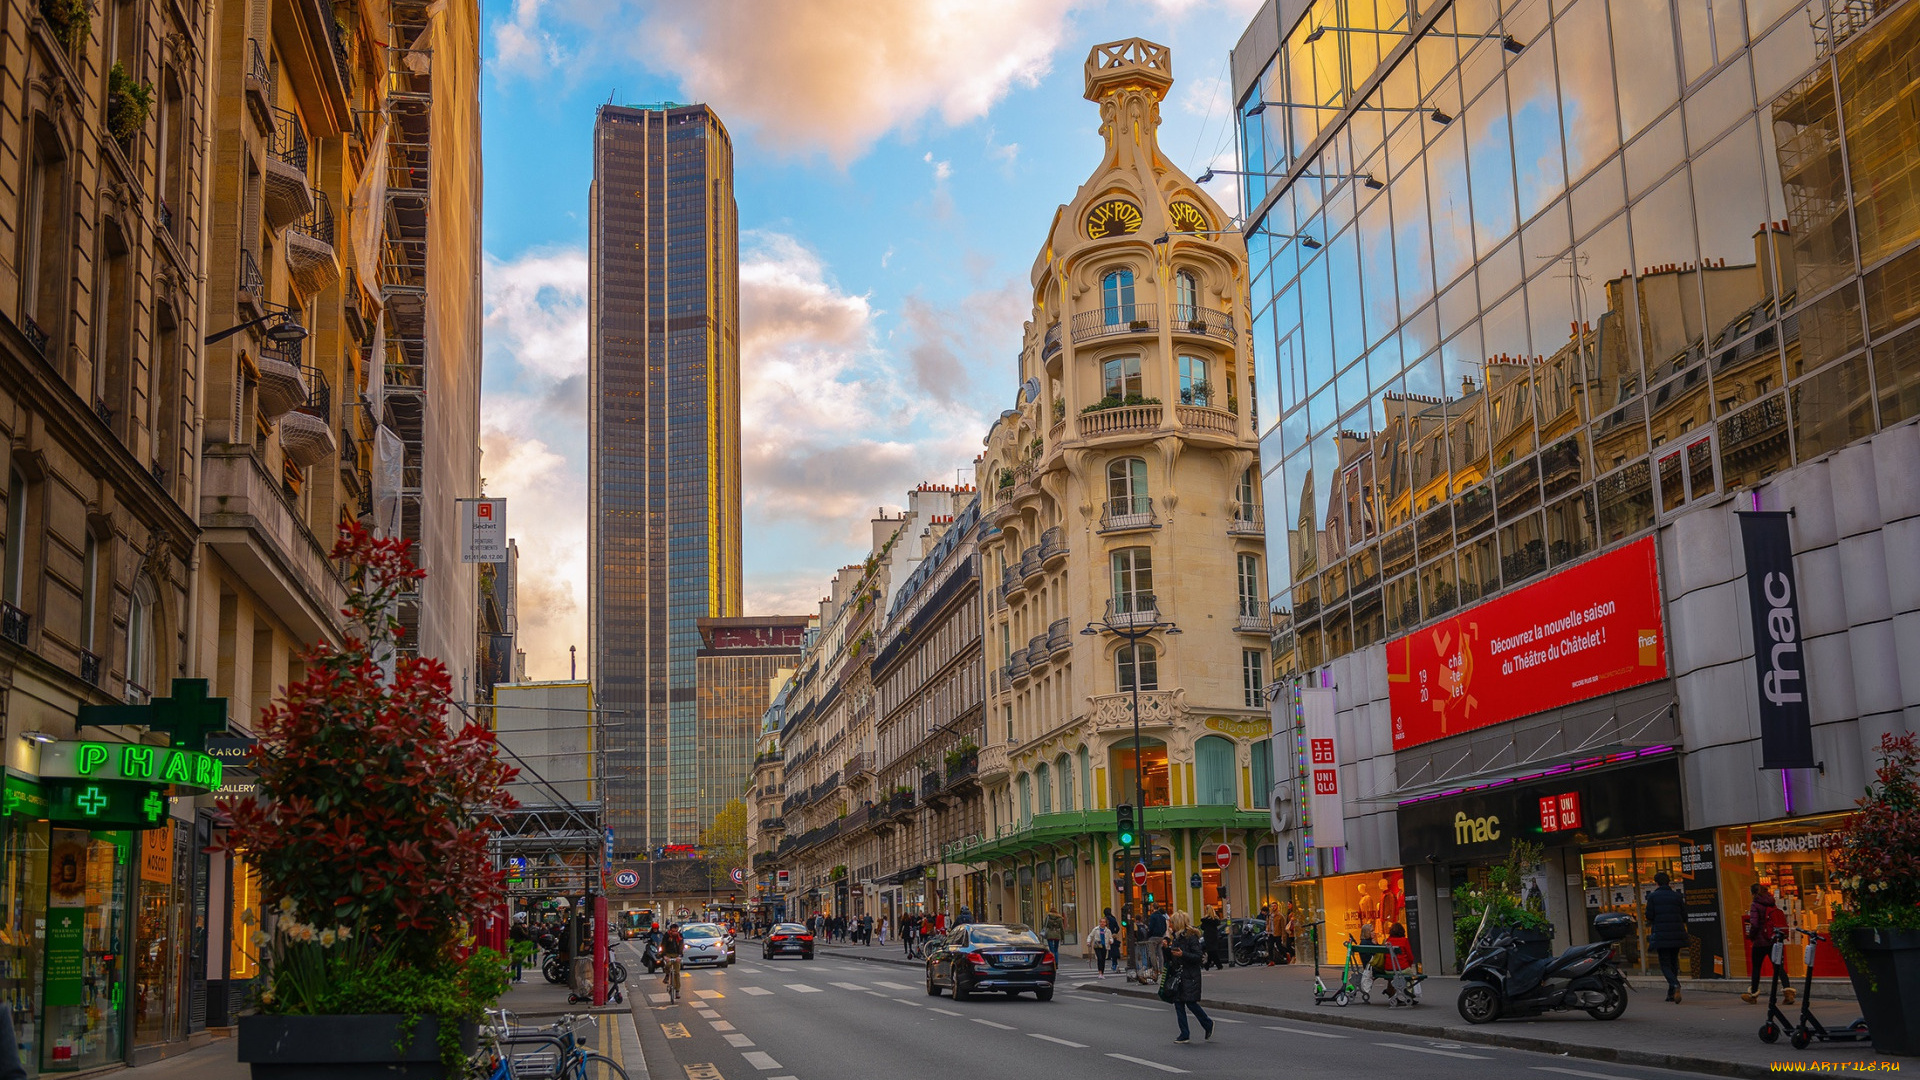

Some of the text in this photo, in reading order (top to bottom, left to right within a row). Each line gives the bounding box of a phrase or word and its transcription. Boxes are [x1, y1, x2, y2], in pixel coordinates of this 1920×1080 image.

[1490, 600, 1616, 655] Découvrez la nouvelle saison
[1637, 634, 1658, 649] fnac
[1763, 571, 1802, 706] fnac
[1502, 659, 1514, 676] du
[1513, 649, 1547, 672] Théâtre
[1547, 642, 1560, 660] du
[1560, 629, 1602, 656] Châtelet
[1448, 652, 1463, 669] châ
[1418, 669, 1428, 684] 19
[1419, 687, 1429, 703] 20
[1451, 683, 1464, 698] let
[1217, 719, 1268, 735] BISCUITS
[1316, 772, 1334, 781] UNI
[1317, 782, 1335, 792] QLO
[1560, 797, 1574, 811] UNI
[1562, 811, 1576, 825] QLO
[1454, 811, 1501, 845] fnac
[1724, 844, 1750, 857] FNAC,
[1750, 839, 1775, 853] C'EST
[1776, 837, 1797, 851] BON
[618, 873, 636, 883] C&A
